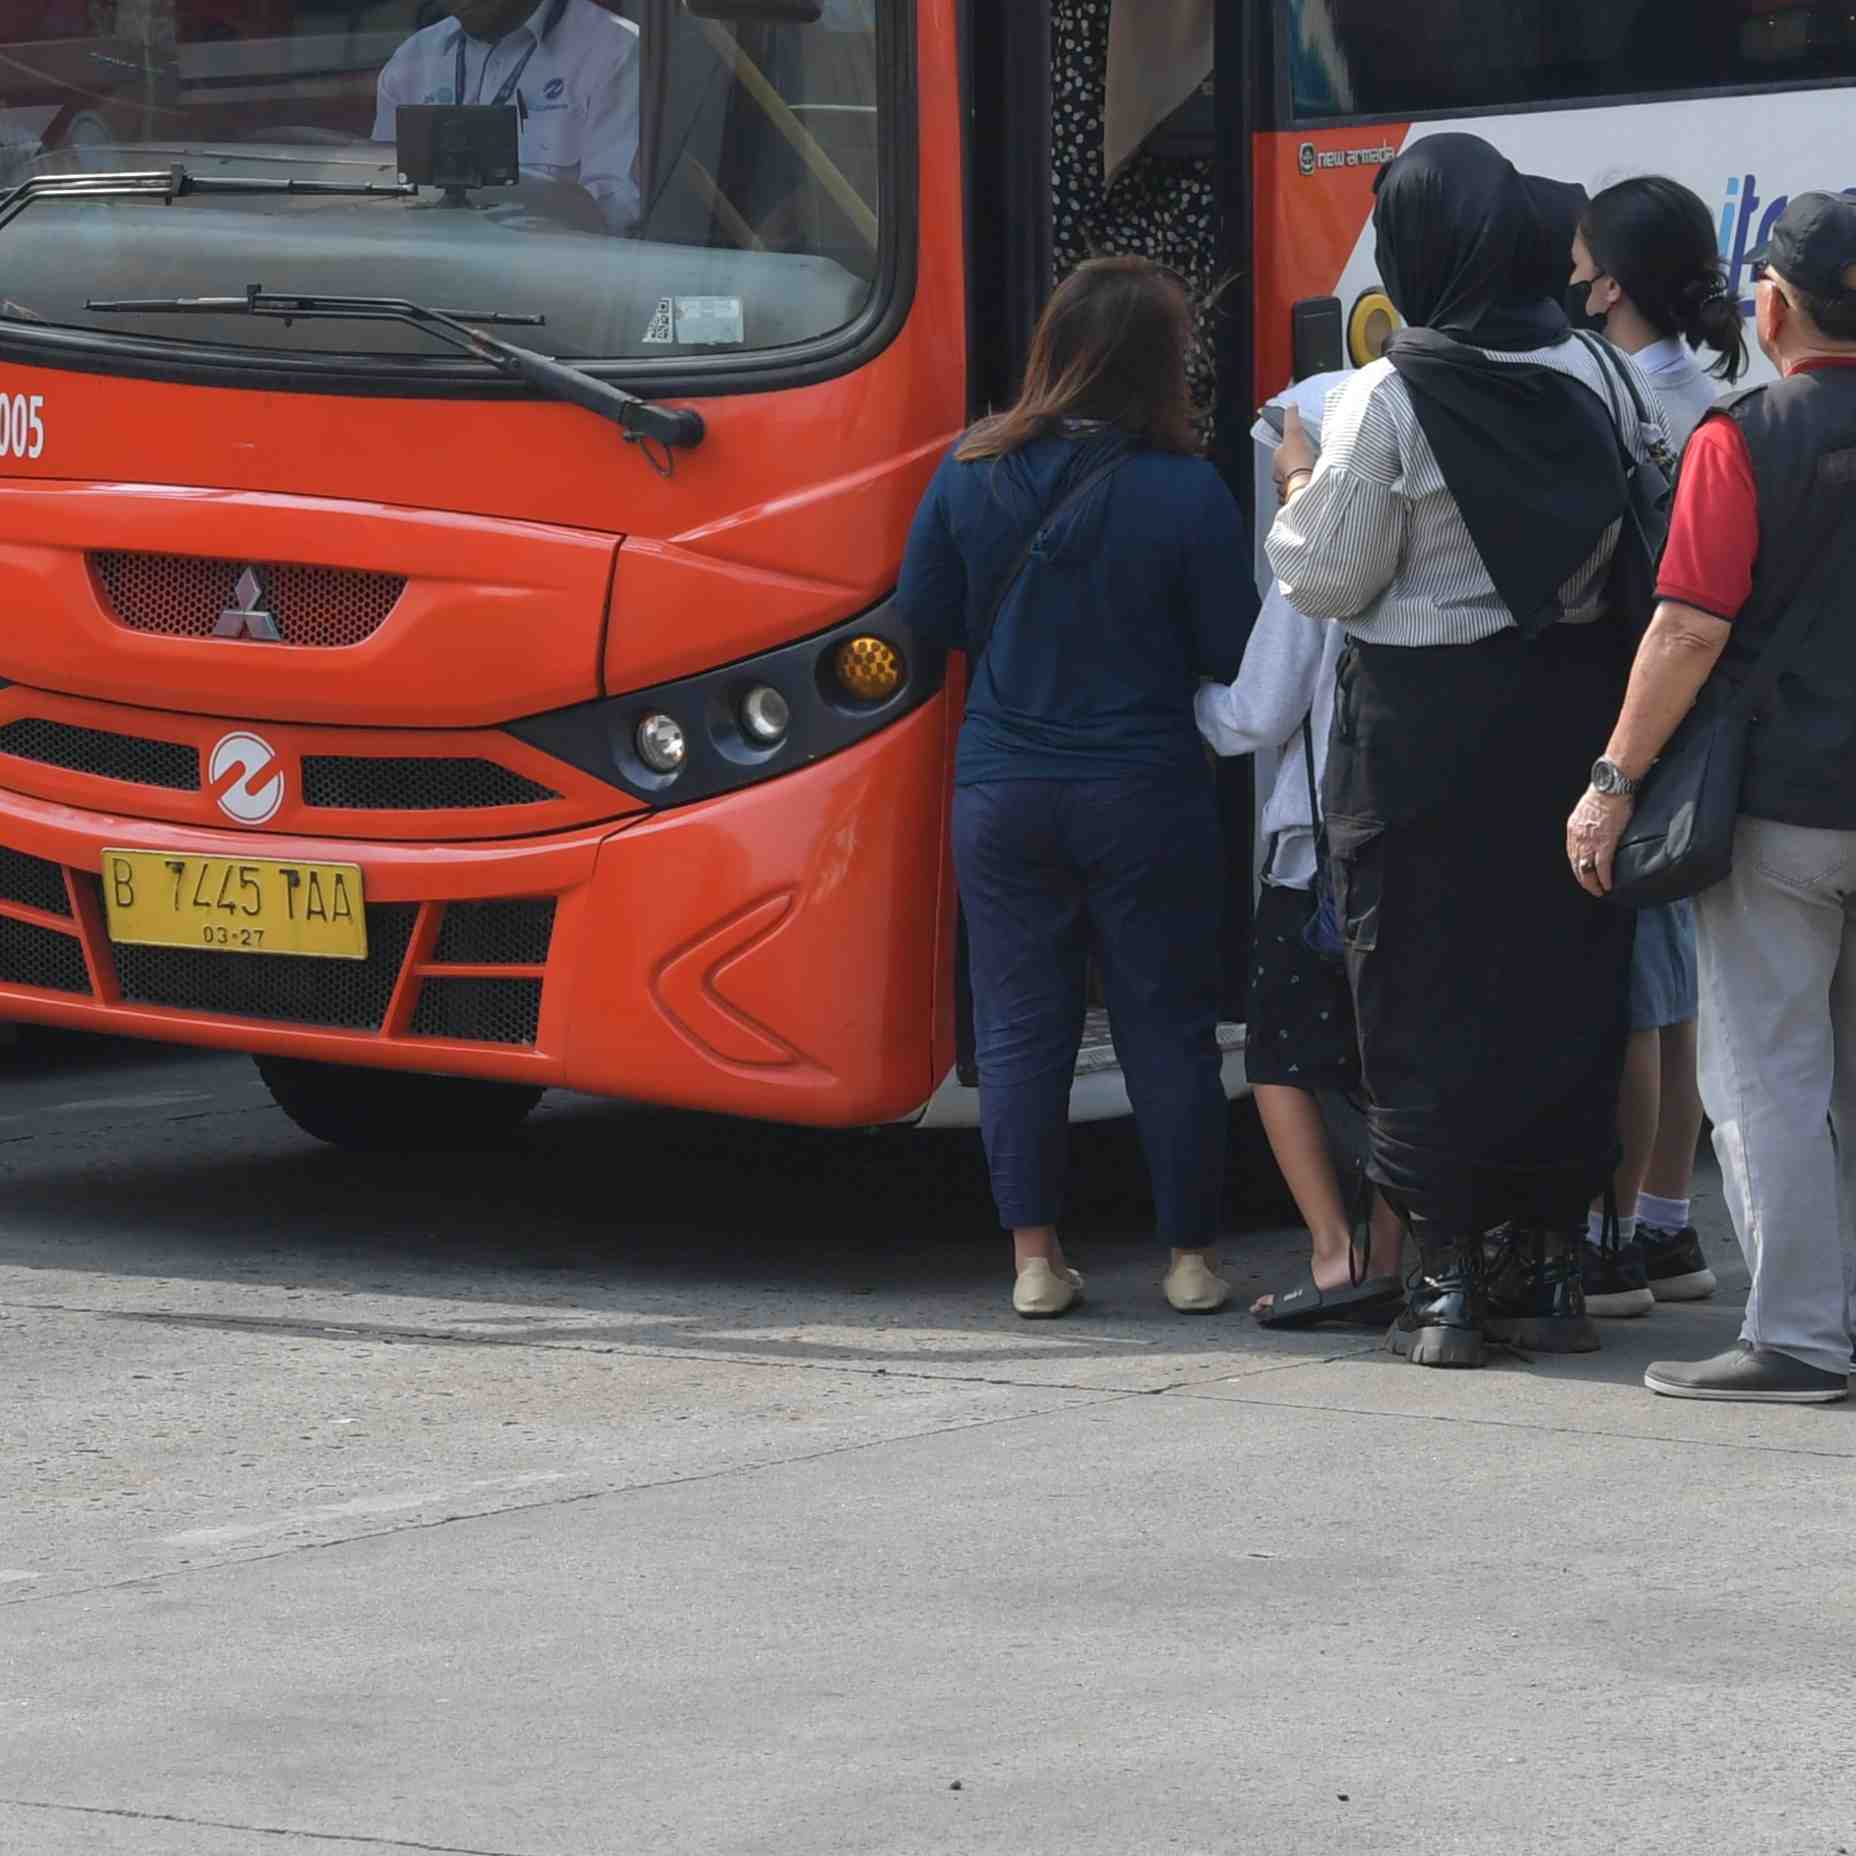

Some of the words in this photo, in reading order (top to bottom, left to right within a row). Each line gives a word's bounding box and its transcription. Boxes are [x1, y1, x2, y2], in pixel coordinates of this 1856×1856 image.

[1317, 151, 1345, 169] new
[112, 857, 135, 908] B
[164, 860, 262, 917] 7445
[279, 868, 354, 923] TAA
